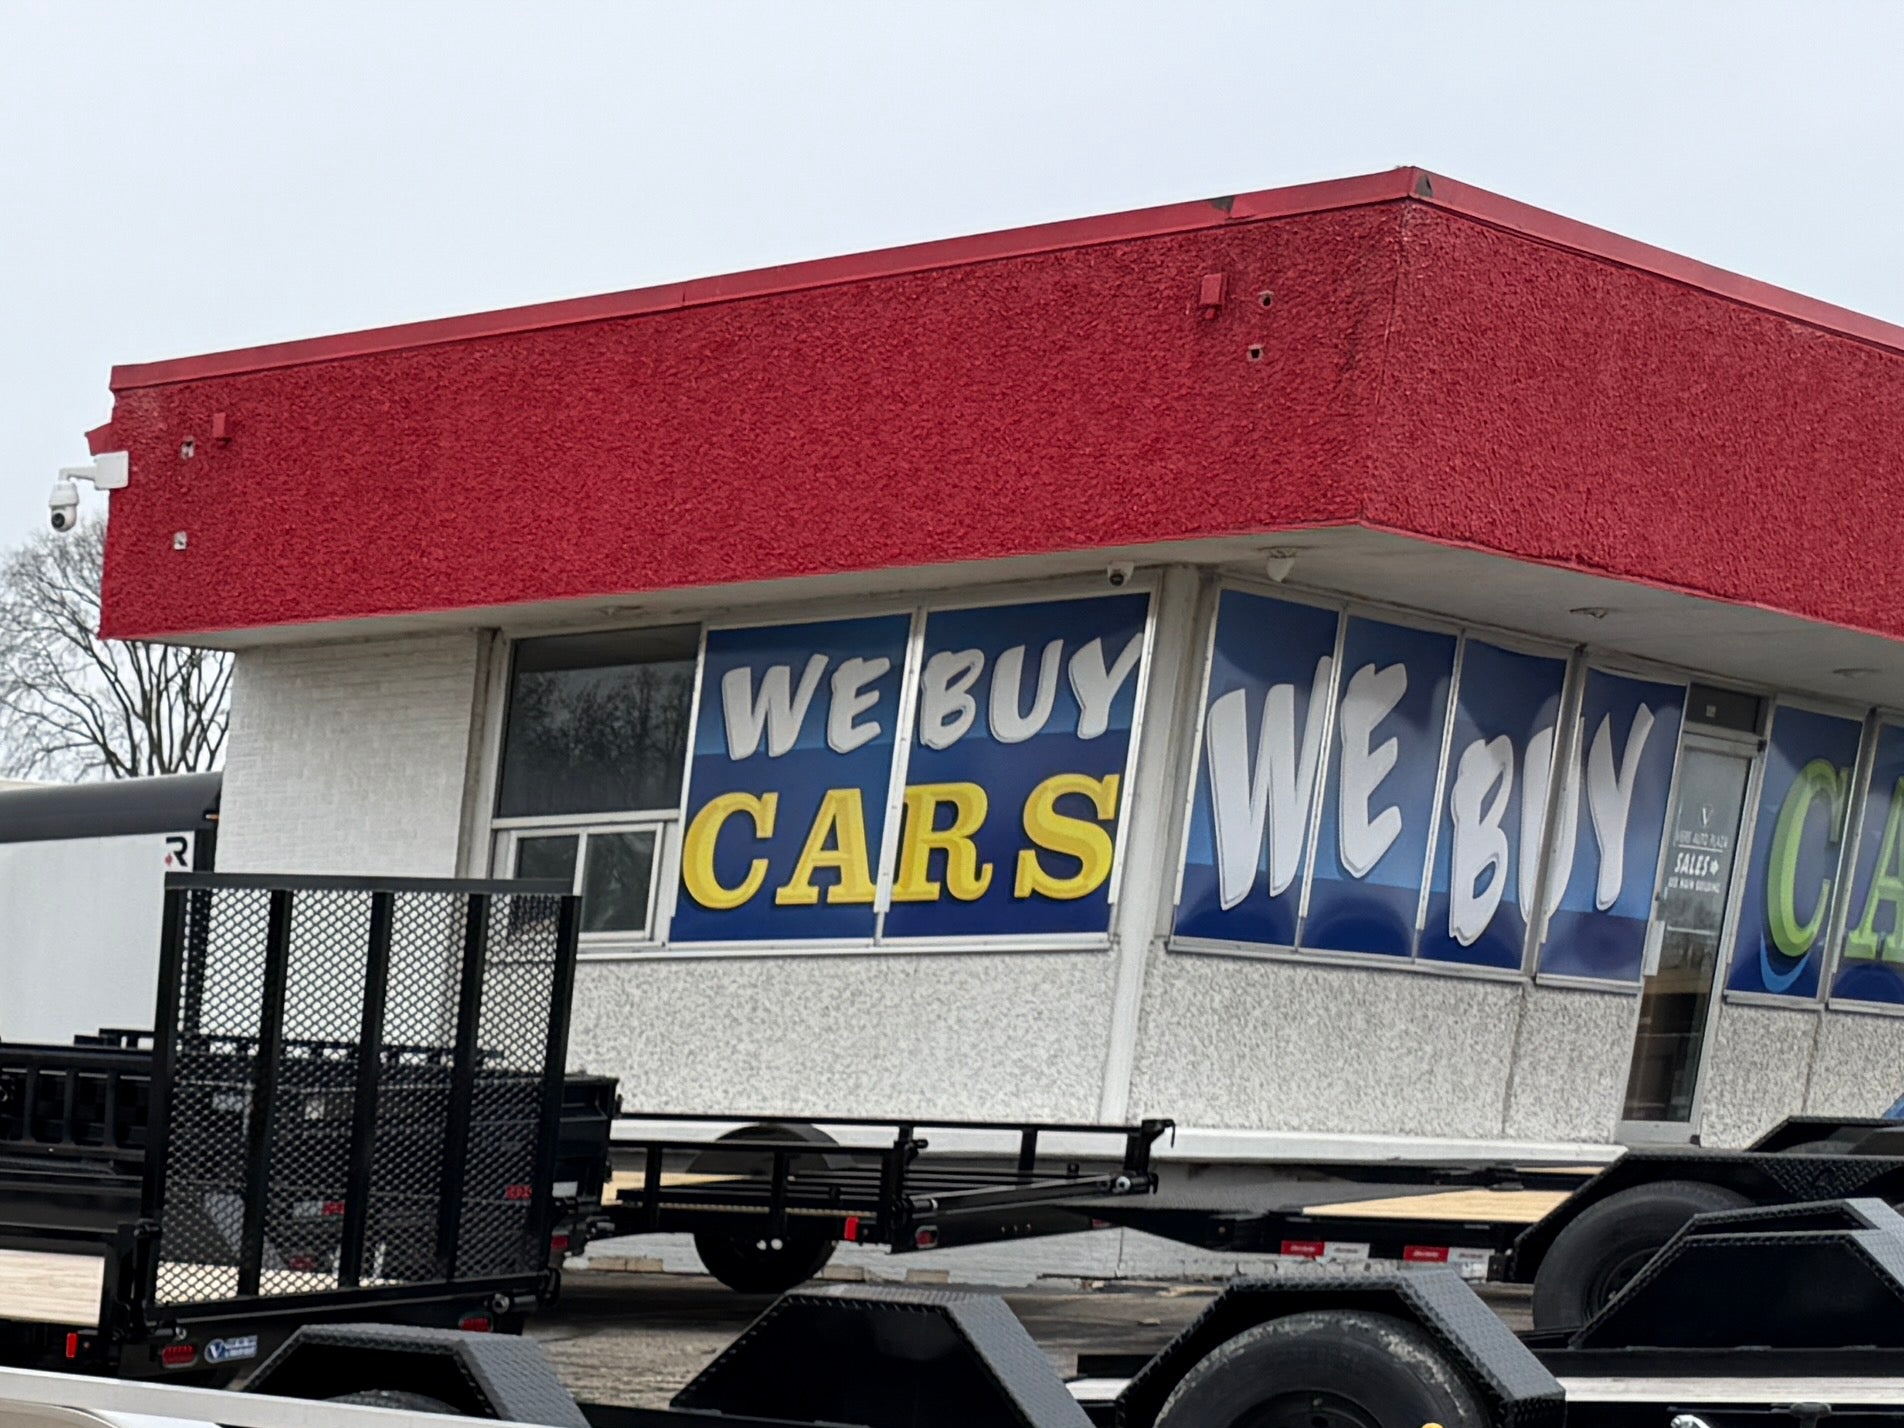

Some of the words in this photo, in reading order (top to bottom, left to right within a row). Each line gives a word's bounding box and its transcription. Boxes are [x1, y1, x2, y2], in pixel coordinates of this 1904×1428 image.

[721, 653, 891, 761] WE
[919, 632, 1143, 751] BUY
[682, 772, 1120, 910] CARS
[1207, 655, 1408, 912] WE
[1448, 702, 1655, 947] BUY
[1674, 852, 1710, 877] SALES
